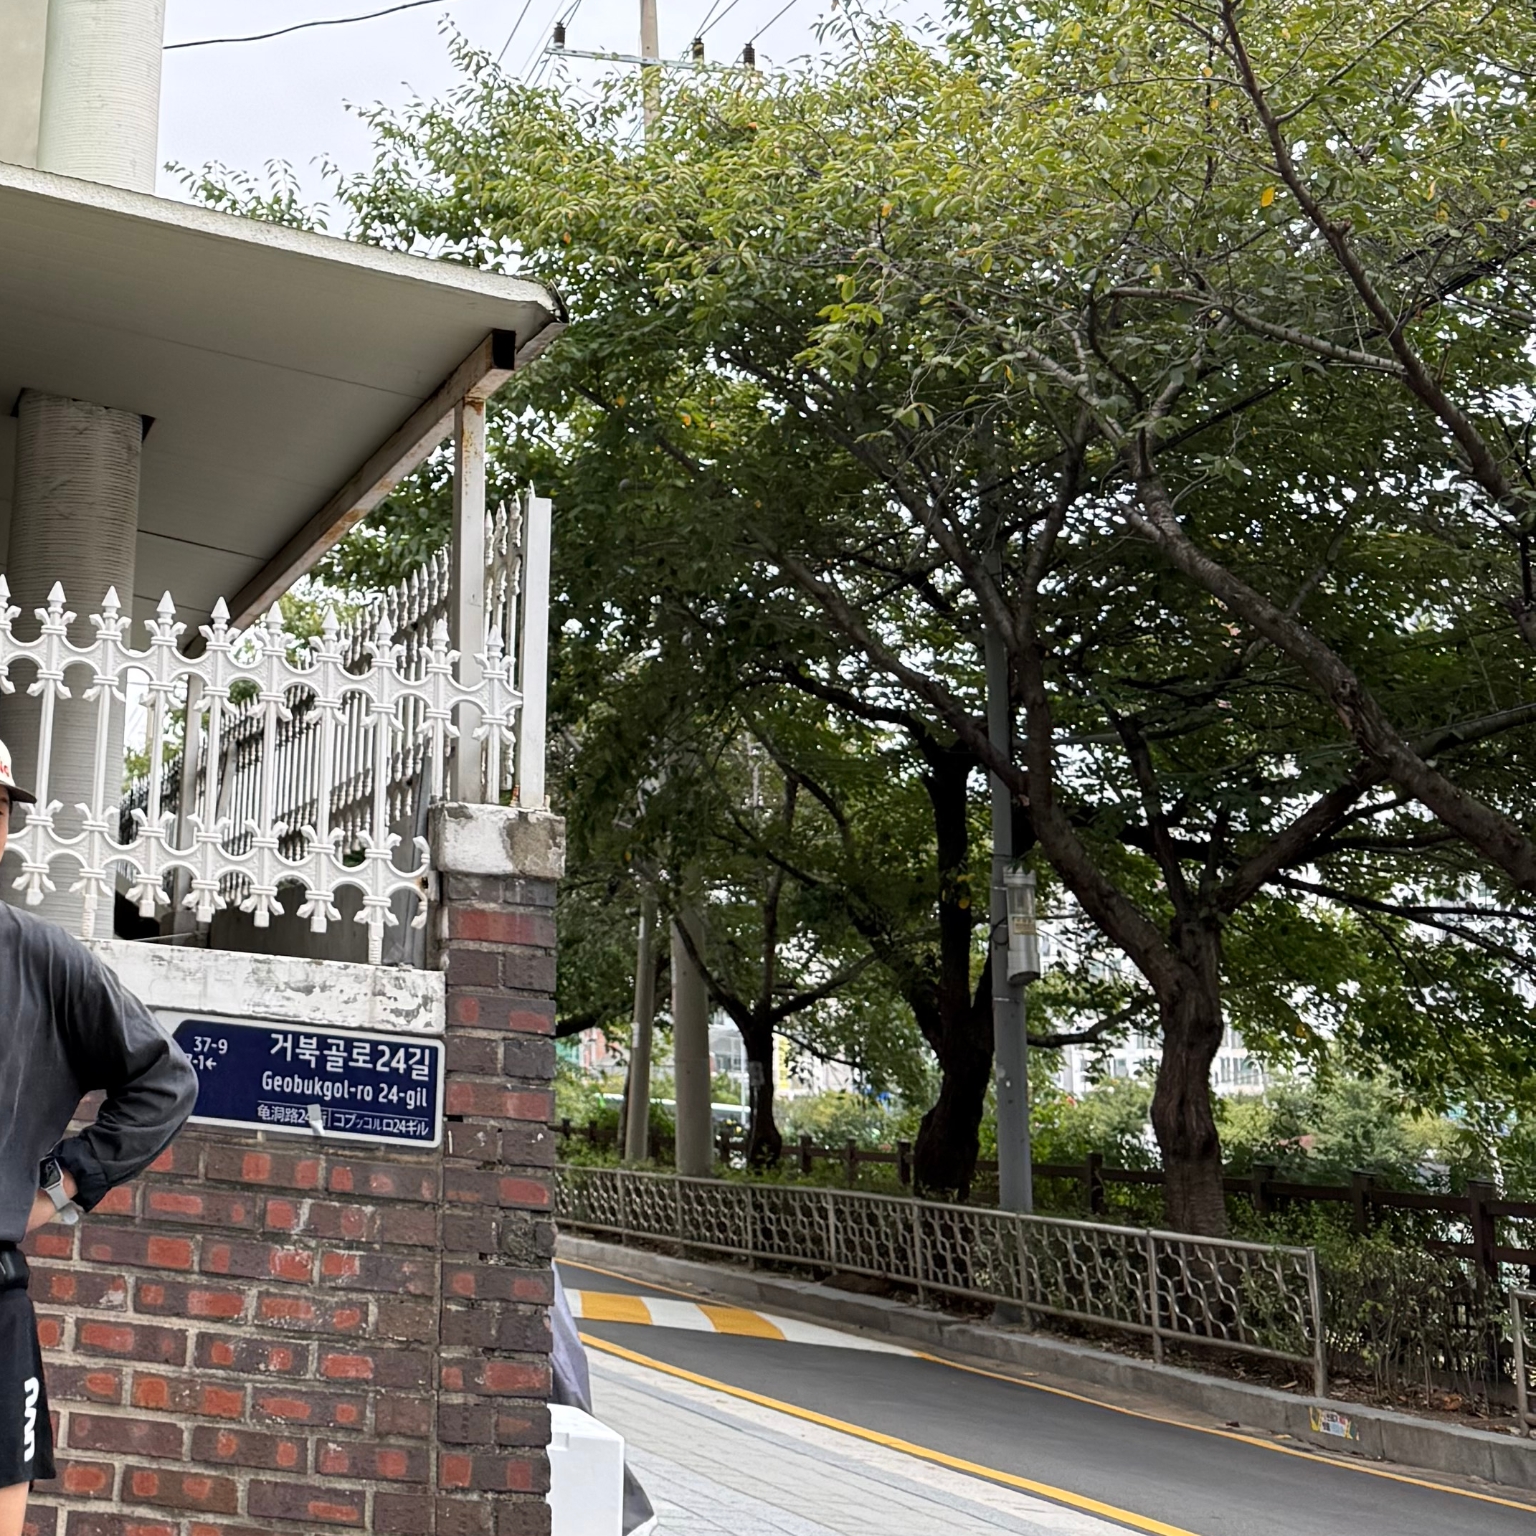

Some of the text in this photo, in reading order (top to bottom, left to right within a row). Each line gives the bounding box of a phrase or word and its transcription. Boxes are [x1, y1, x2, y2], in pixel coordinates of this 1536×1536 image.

[193, 1036, 228, 1054] 37-9
[269, 1033, 430, 1081] 거북골로24길
[262, 1071, 428, 1109] Geobukgol-ro 24-gil
